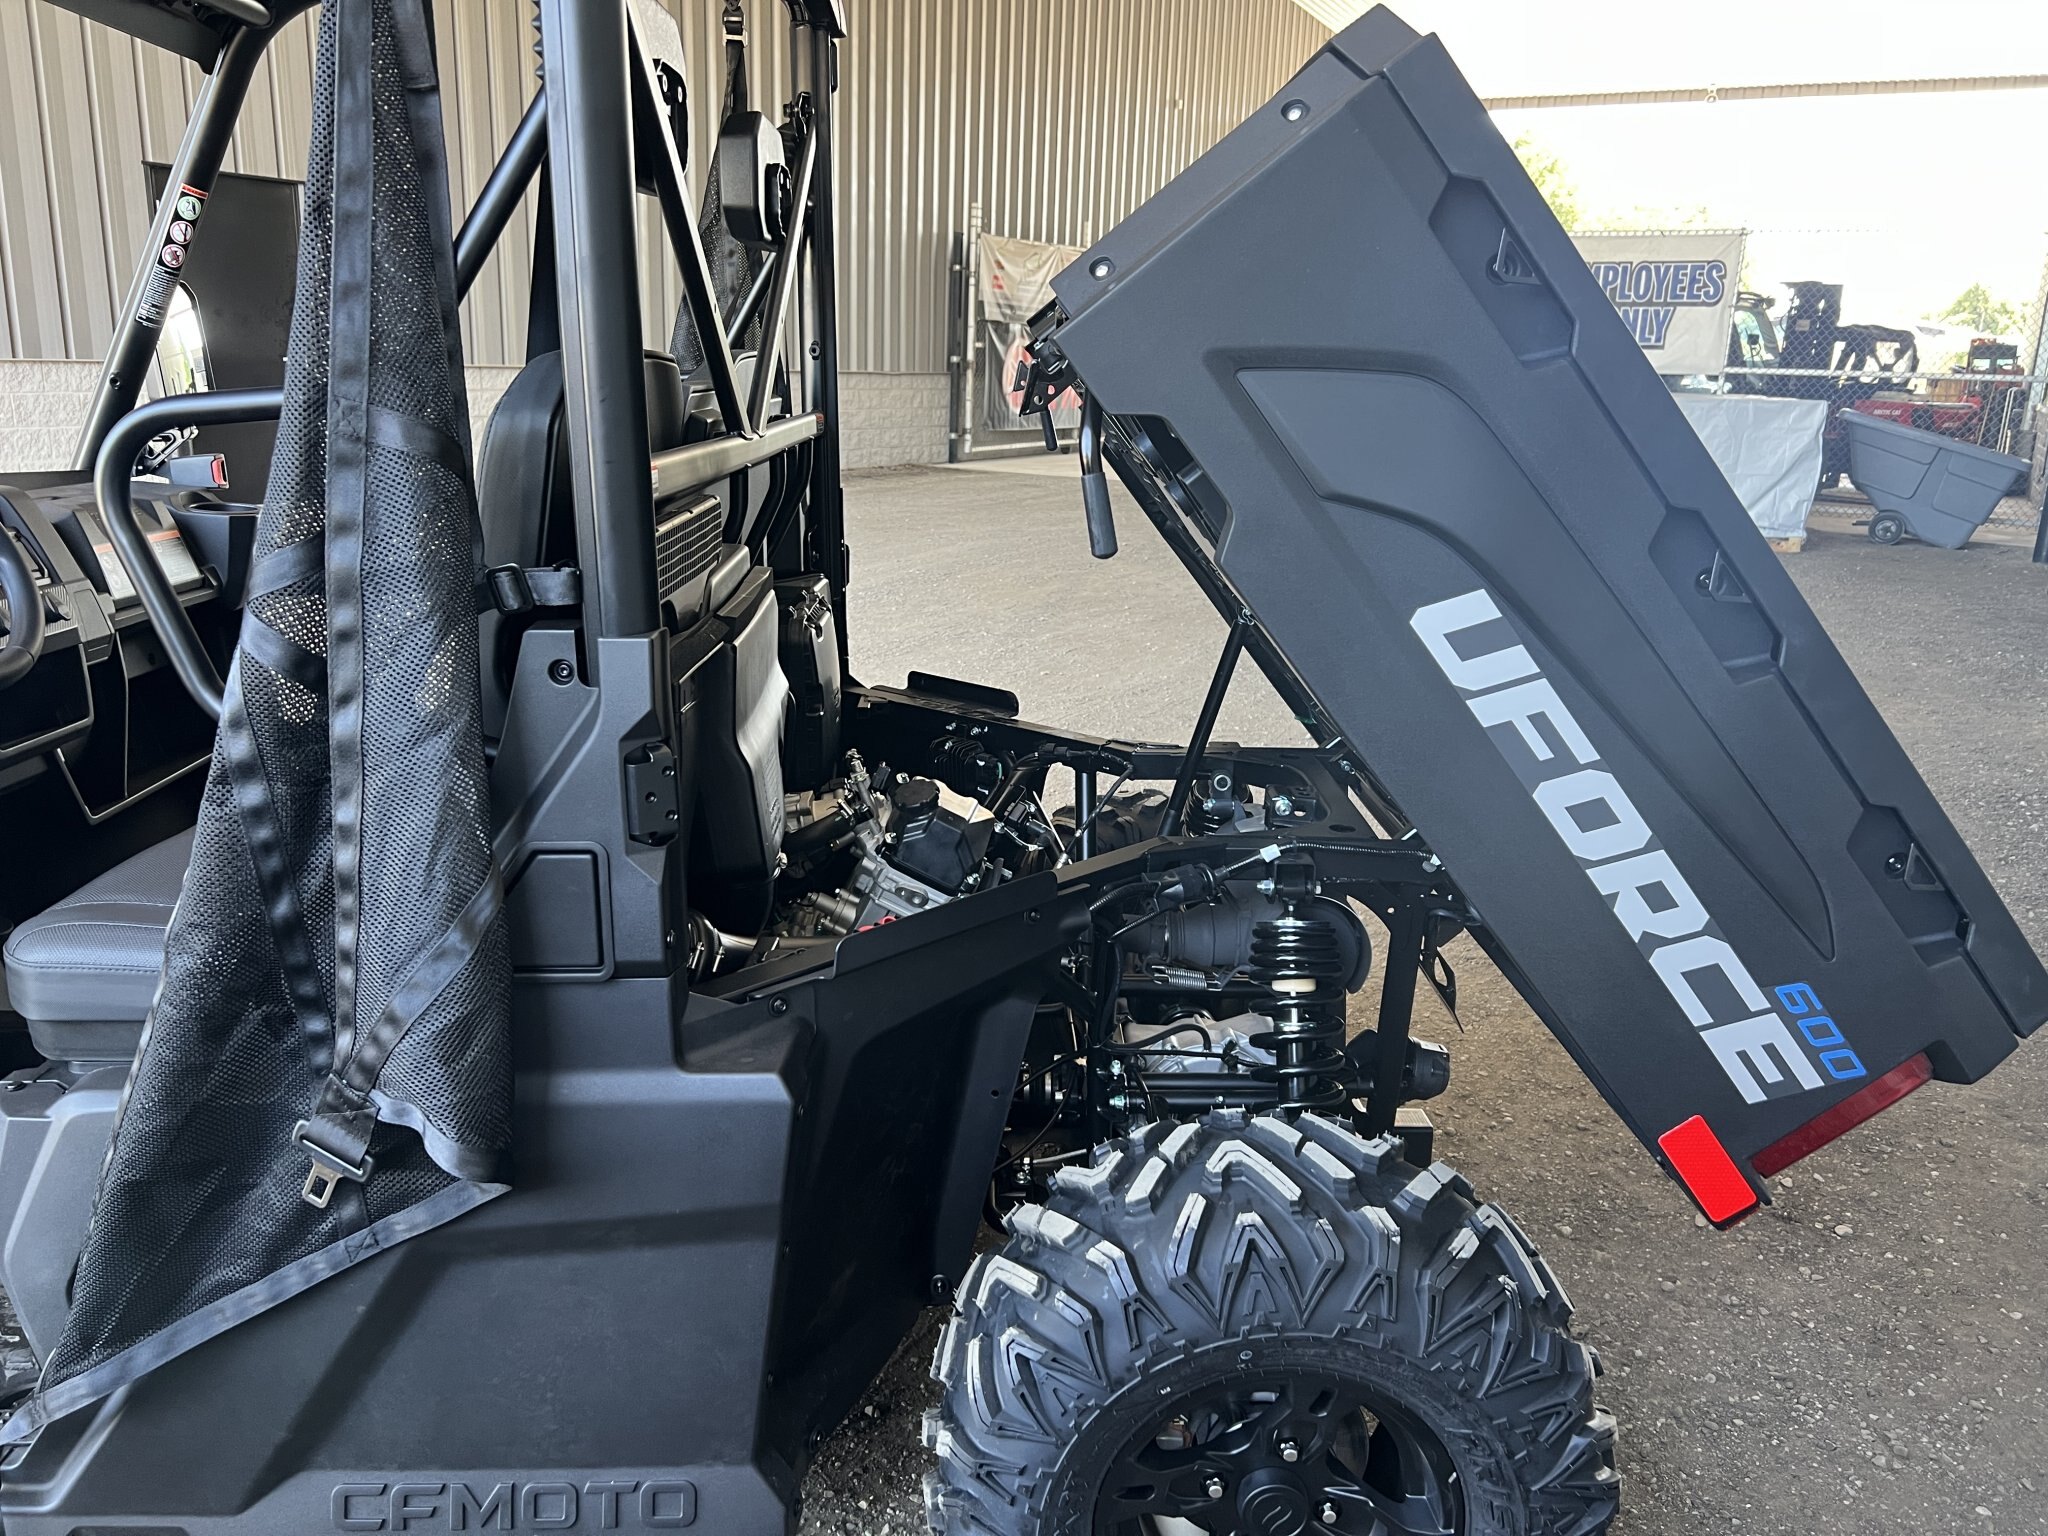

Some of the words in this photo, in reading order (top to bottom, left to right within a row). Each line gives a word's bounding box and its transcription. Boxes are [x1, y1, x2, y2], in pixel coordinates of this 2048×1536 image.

[1587, 261, 1726, 303] PLOYEES
[1619, 305, 1675, 347] NLY
[1410, 589, 1824, 1104] UFORCE
[1775, 983, 1868, 1080] 600
[331, 1480, 699, 1531] CFMOTO
